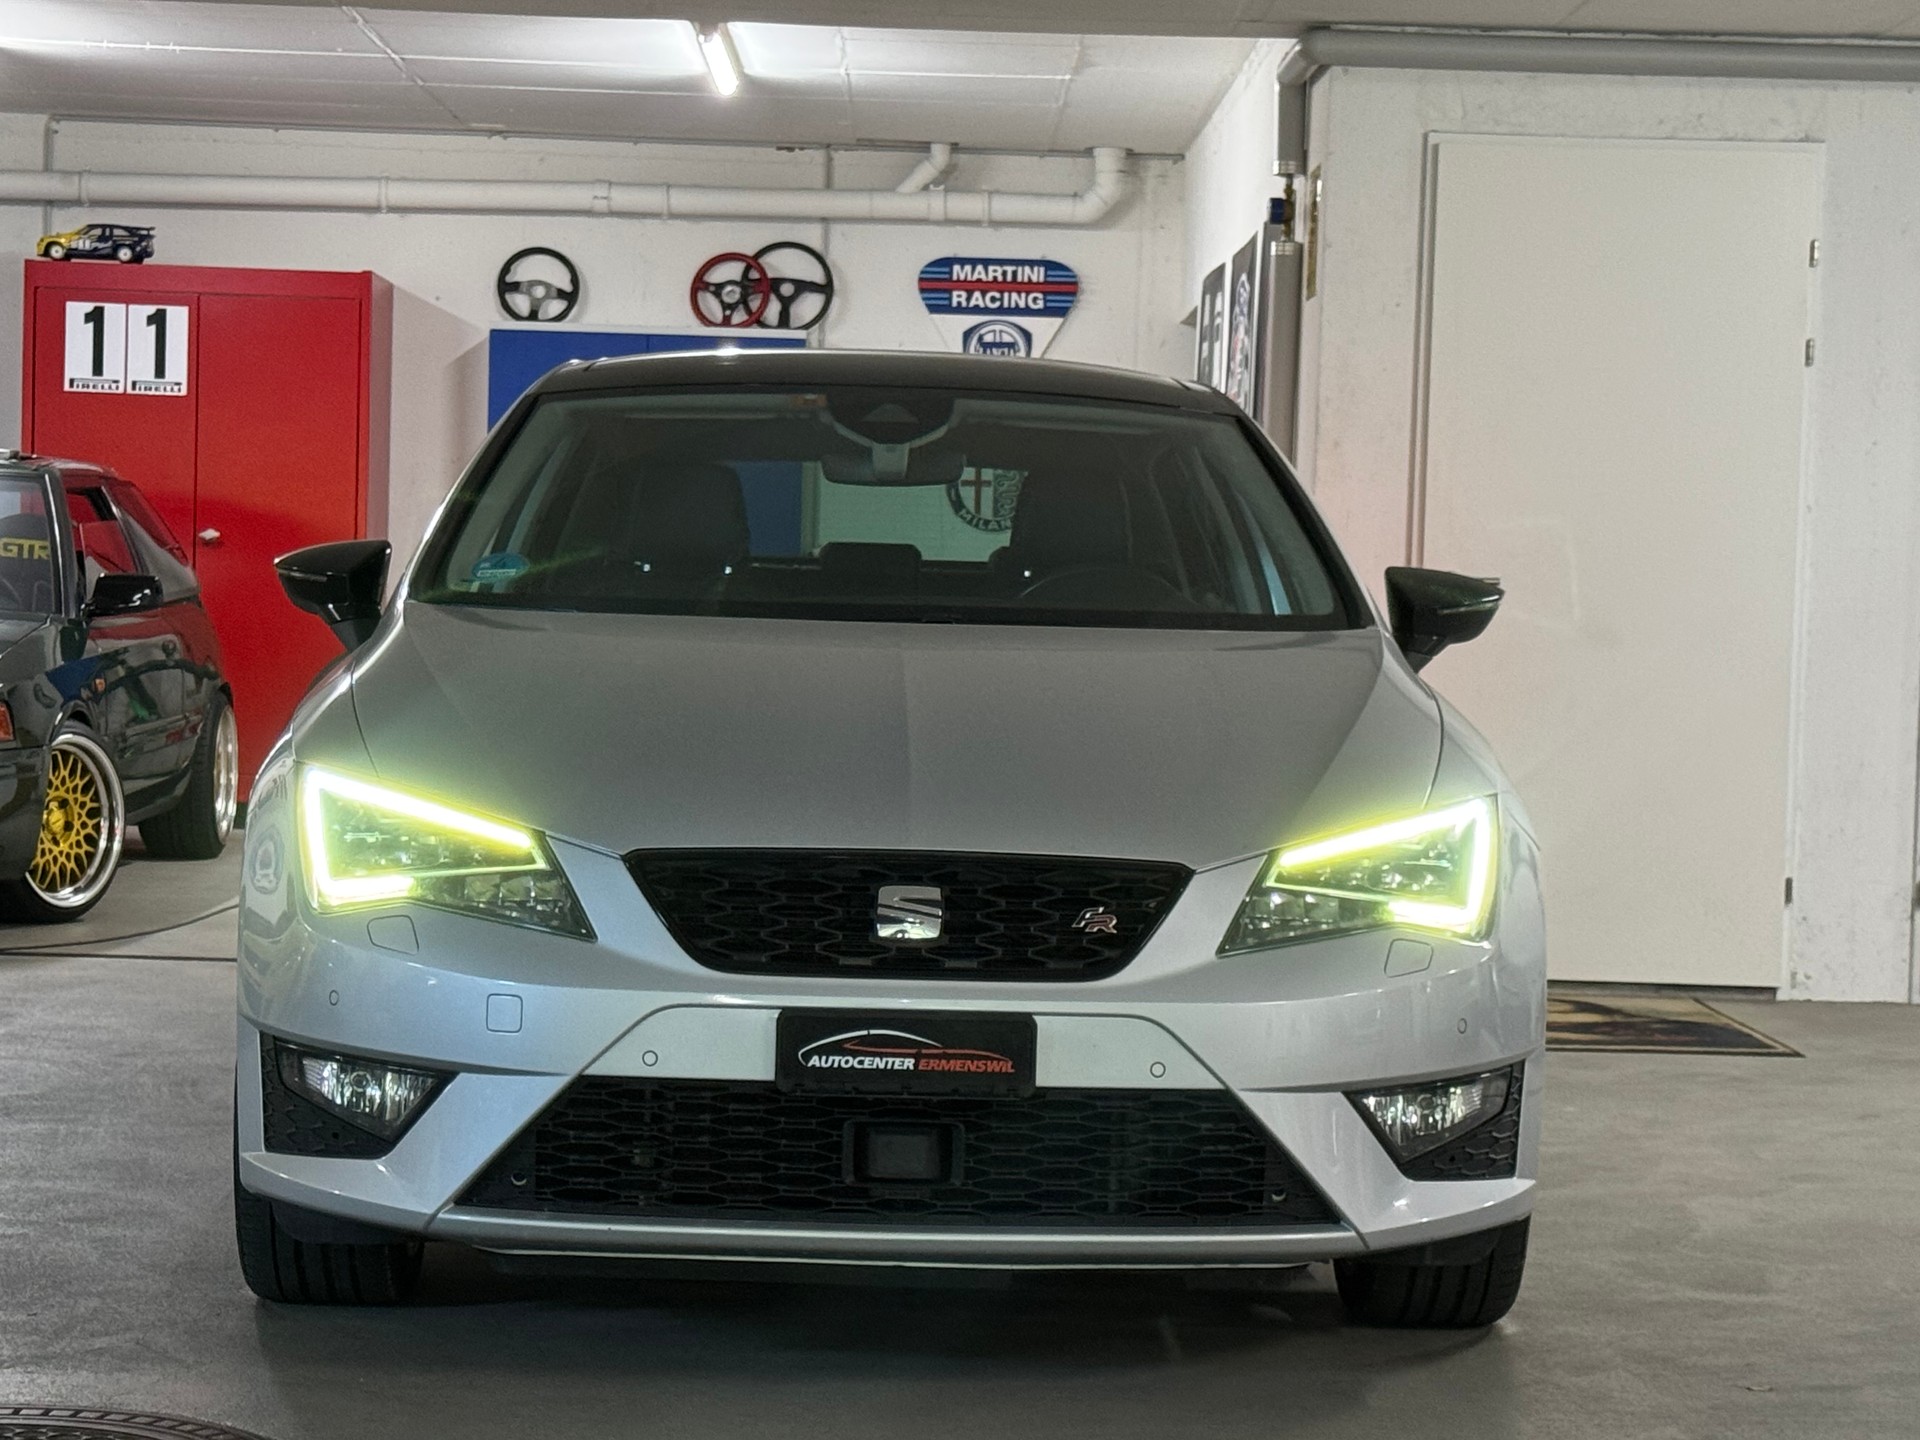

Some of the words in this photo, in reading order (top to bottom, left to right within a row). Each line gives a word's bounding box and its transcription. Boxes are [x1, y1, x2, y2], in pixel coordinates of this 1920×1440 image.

[952, 264, 1045, 283] MARTINI
[951, 290, 1044, 310] RACING
[84, 305, 104, 377] 1
[146, 308, 167, 379] 1
[959, 508, 1011, 531] MILAN
[0, 538, 49, 560] GTR
[1071, 906, 1117, 934] FR
[807, 1055, 915, 1070] AUTOCENTER
[918, 1058, 1014, 1073] ERMENSWIL
